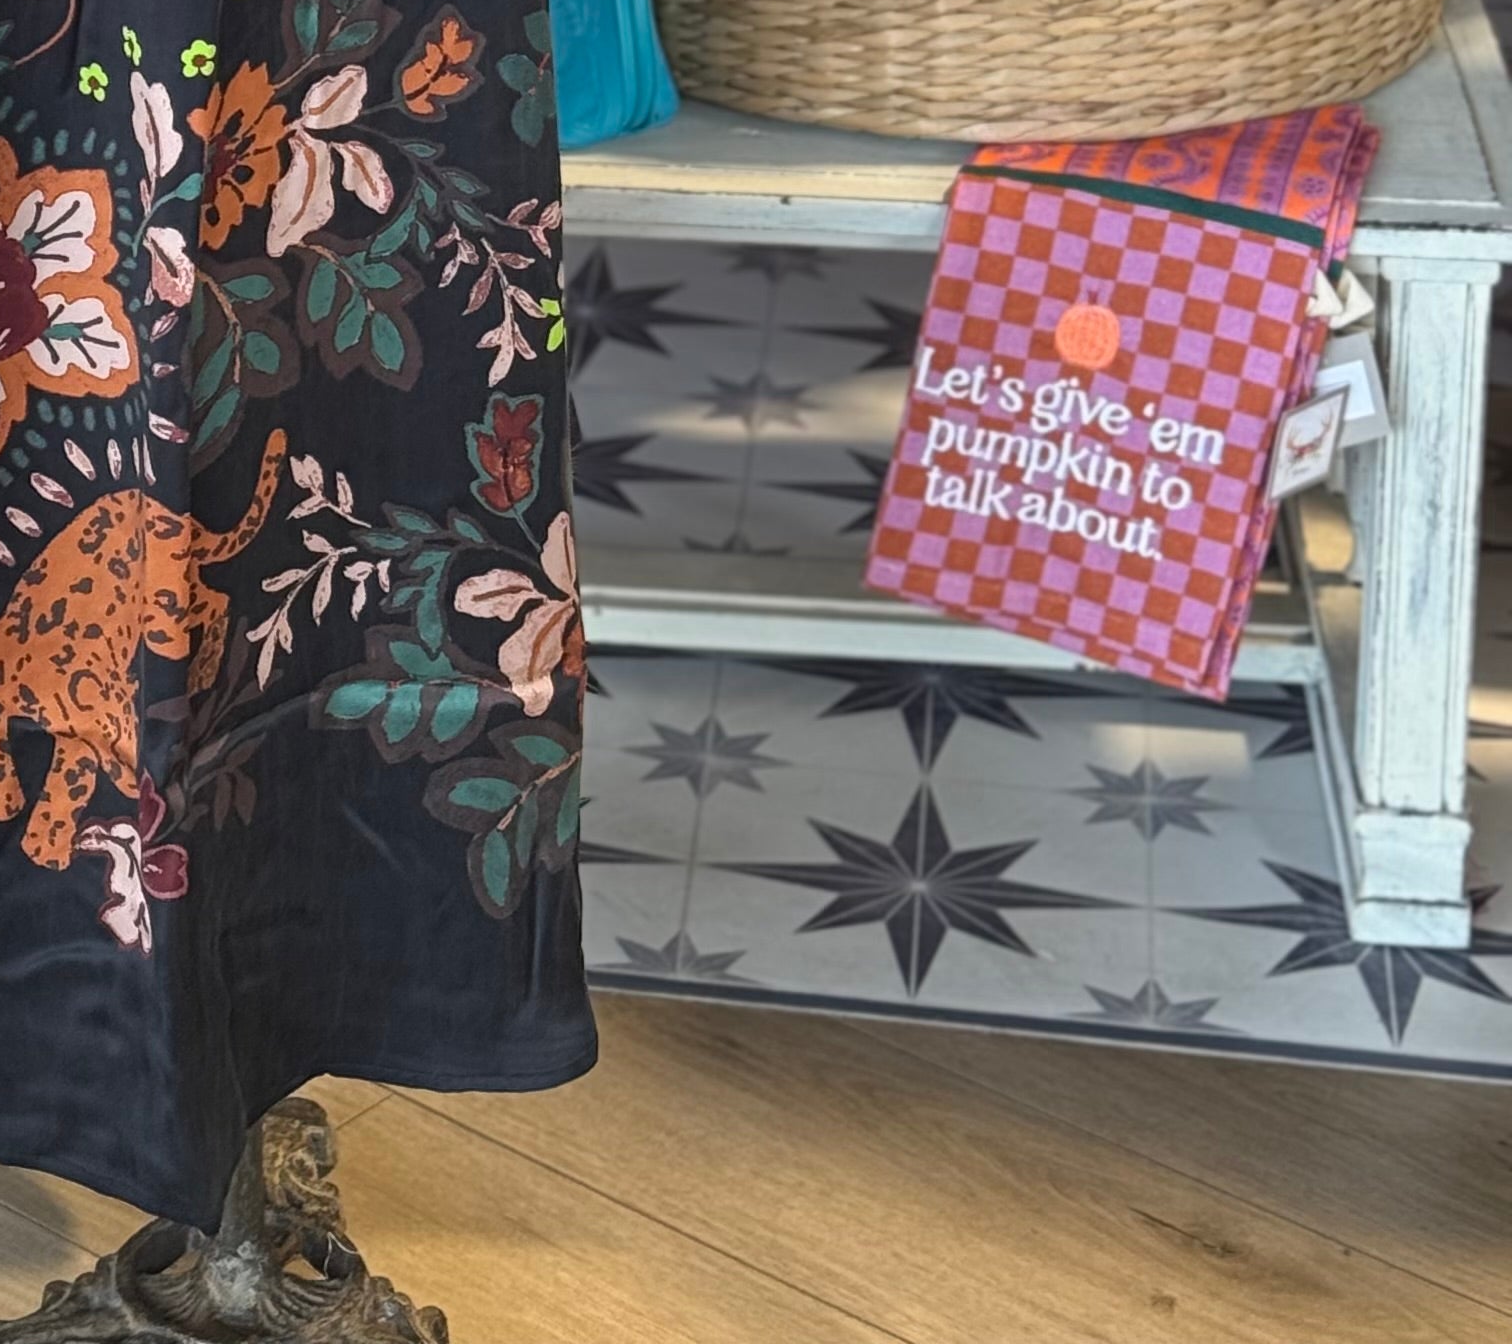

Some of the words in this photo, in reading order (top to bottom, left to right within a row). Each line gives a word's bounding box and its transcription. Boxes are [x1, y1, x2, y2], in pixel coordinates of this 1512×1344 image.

[914, 345, 1027, 414] Let's
[1030, 377, 1134, 439] give
[921, 415, 1134, 498] pumpkin
[1141, 459, 1194, 512] to
[923, 468, 1012, 522] talk
[1016, 490, 1165, 562] about.
